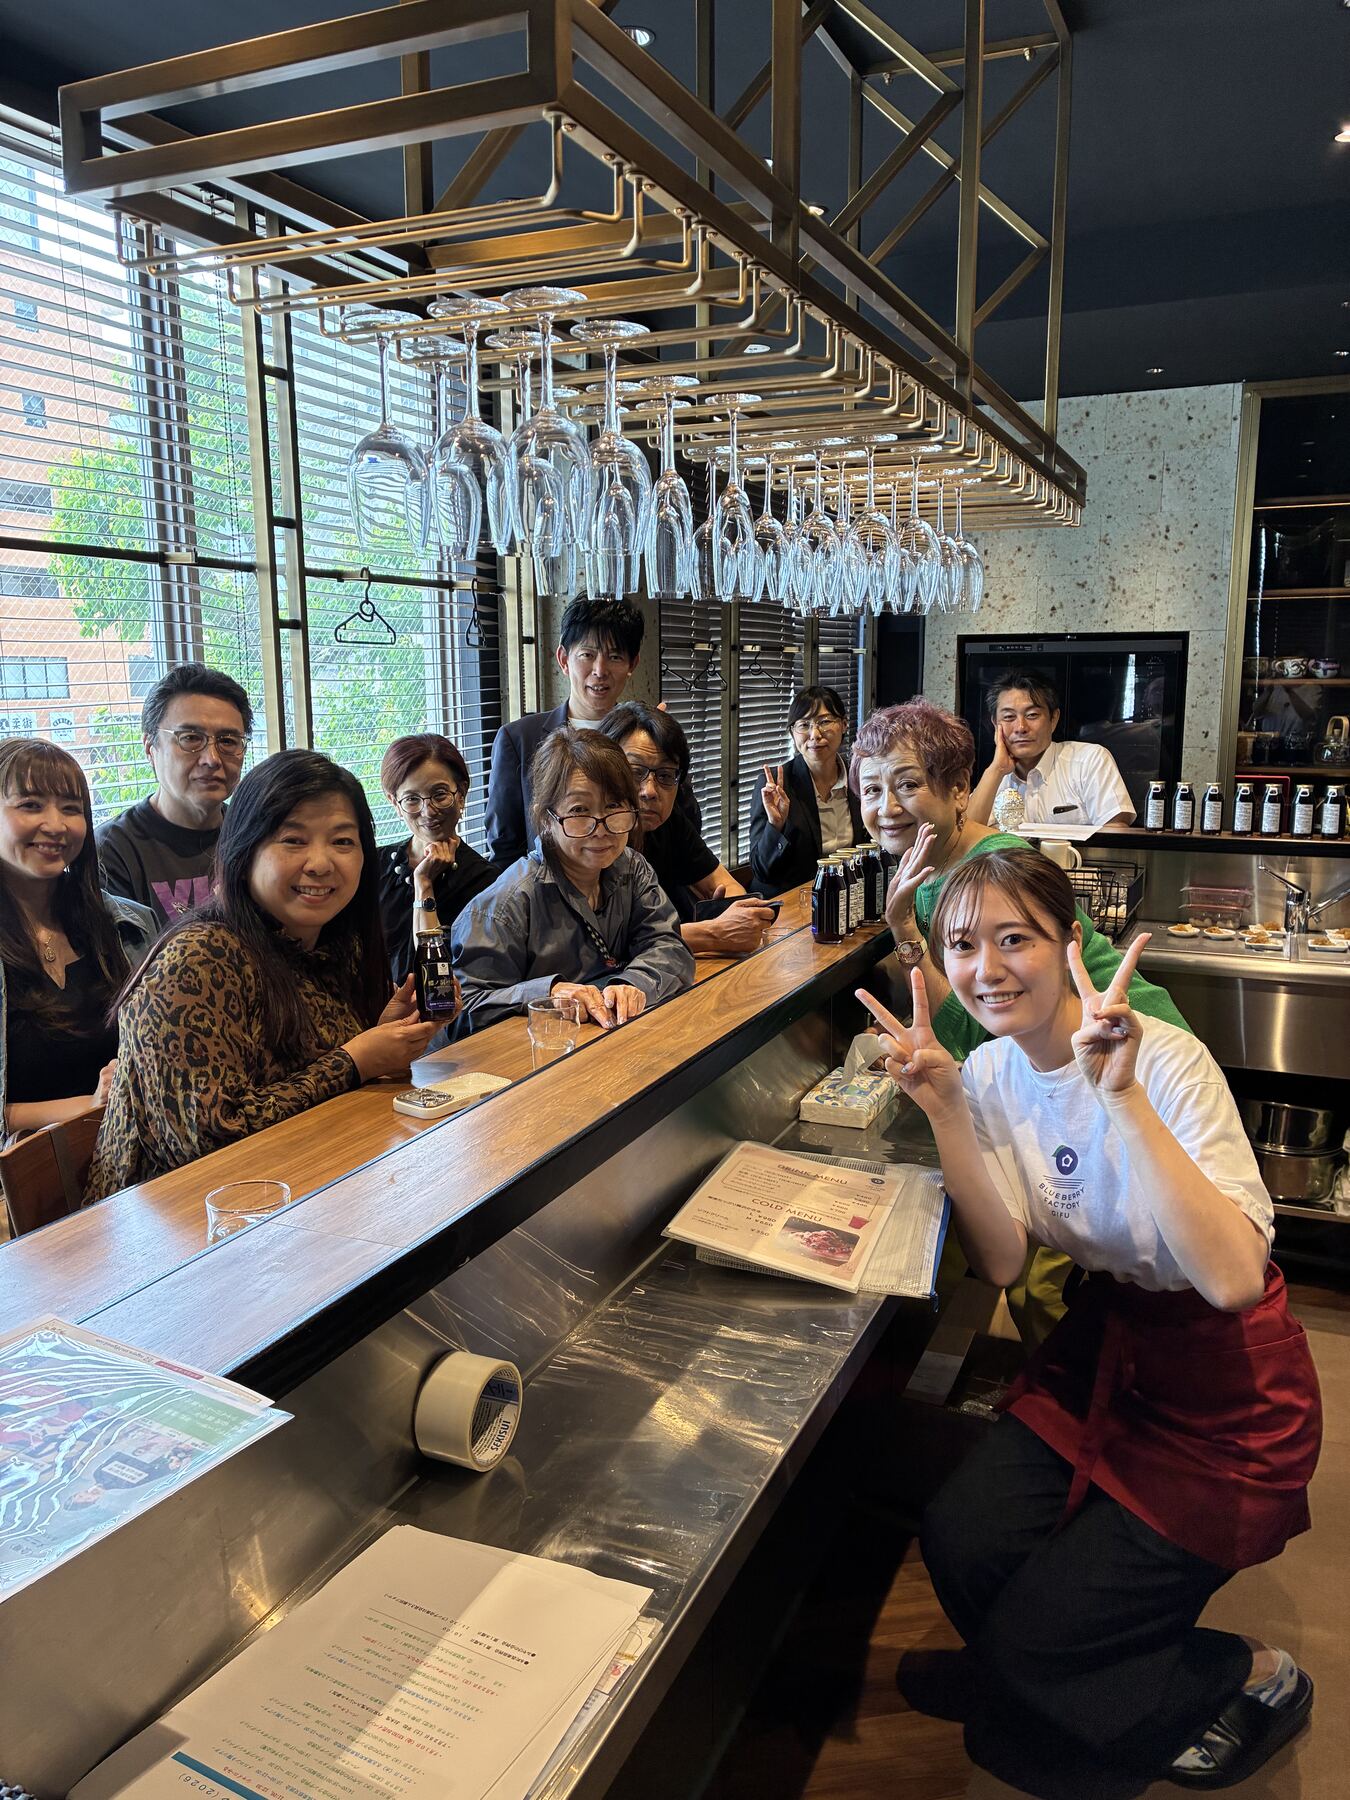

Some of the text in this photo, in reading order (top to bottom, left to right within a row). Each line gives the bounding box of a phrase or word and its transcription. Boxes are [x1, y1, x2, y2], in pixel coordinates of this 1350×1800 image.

[813, 1173, 849, 1184] MENU
[1038, 1182, 1085, 1201] BLUEBERRY
[750, 1198, 784, 1210] COLD
[784, 1207, 824, 1222] MENU
[1043, 1196, 1080, 1209] FACTORY
[1050, 1210, 1070, 1219] GIFU
[490, 1420, 512, 1452] SEKISUI
